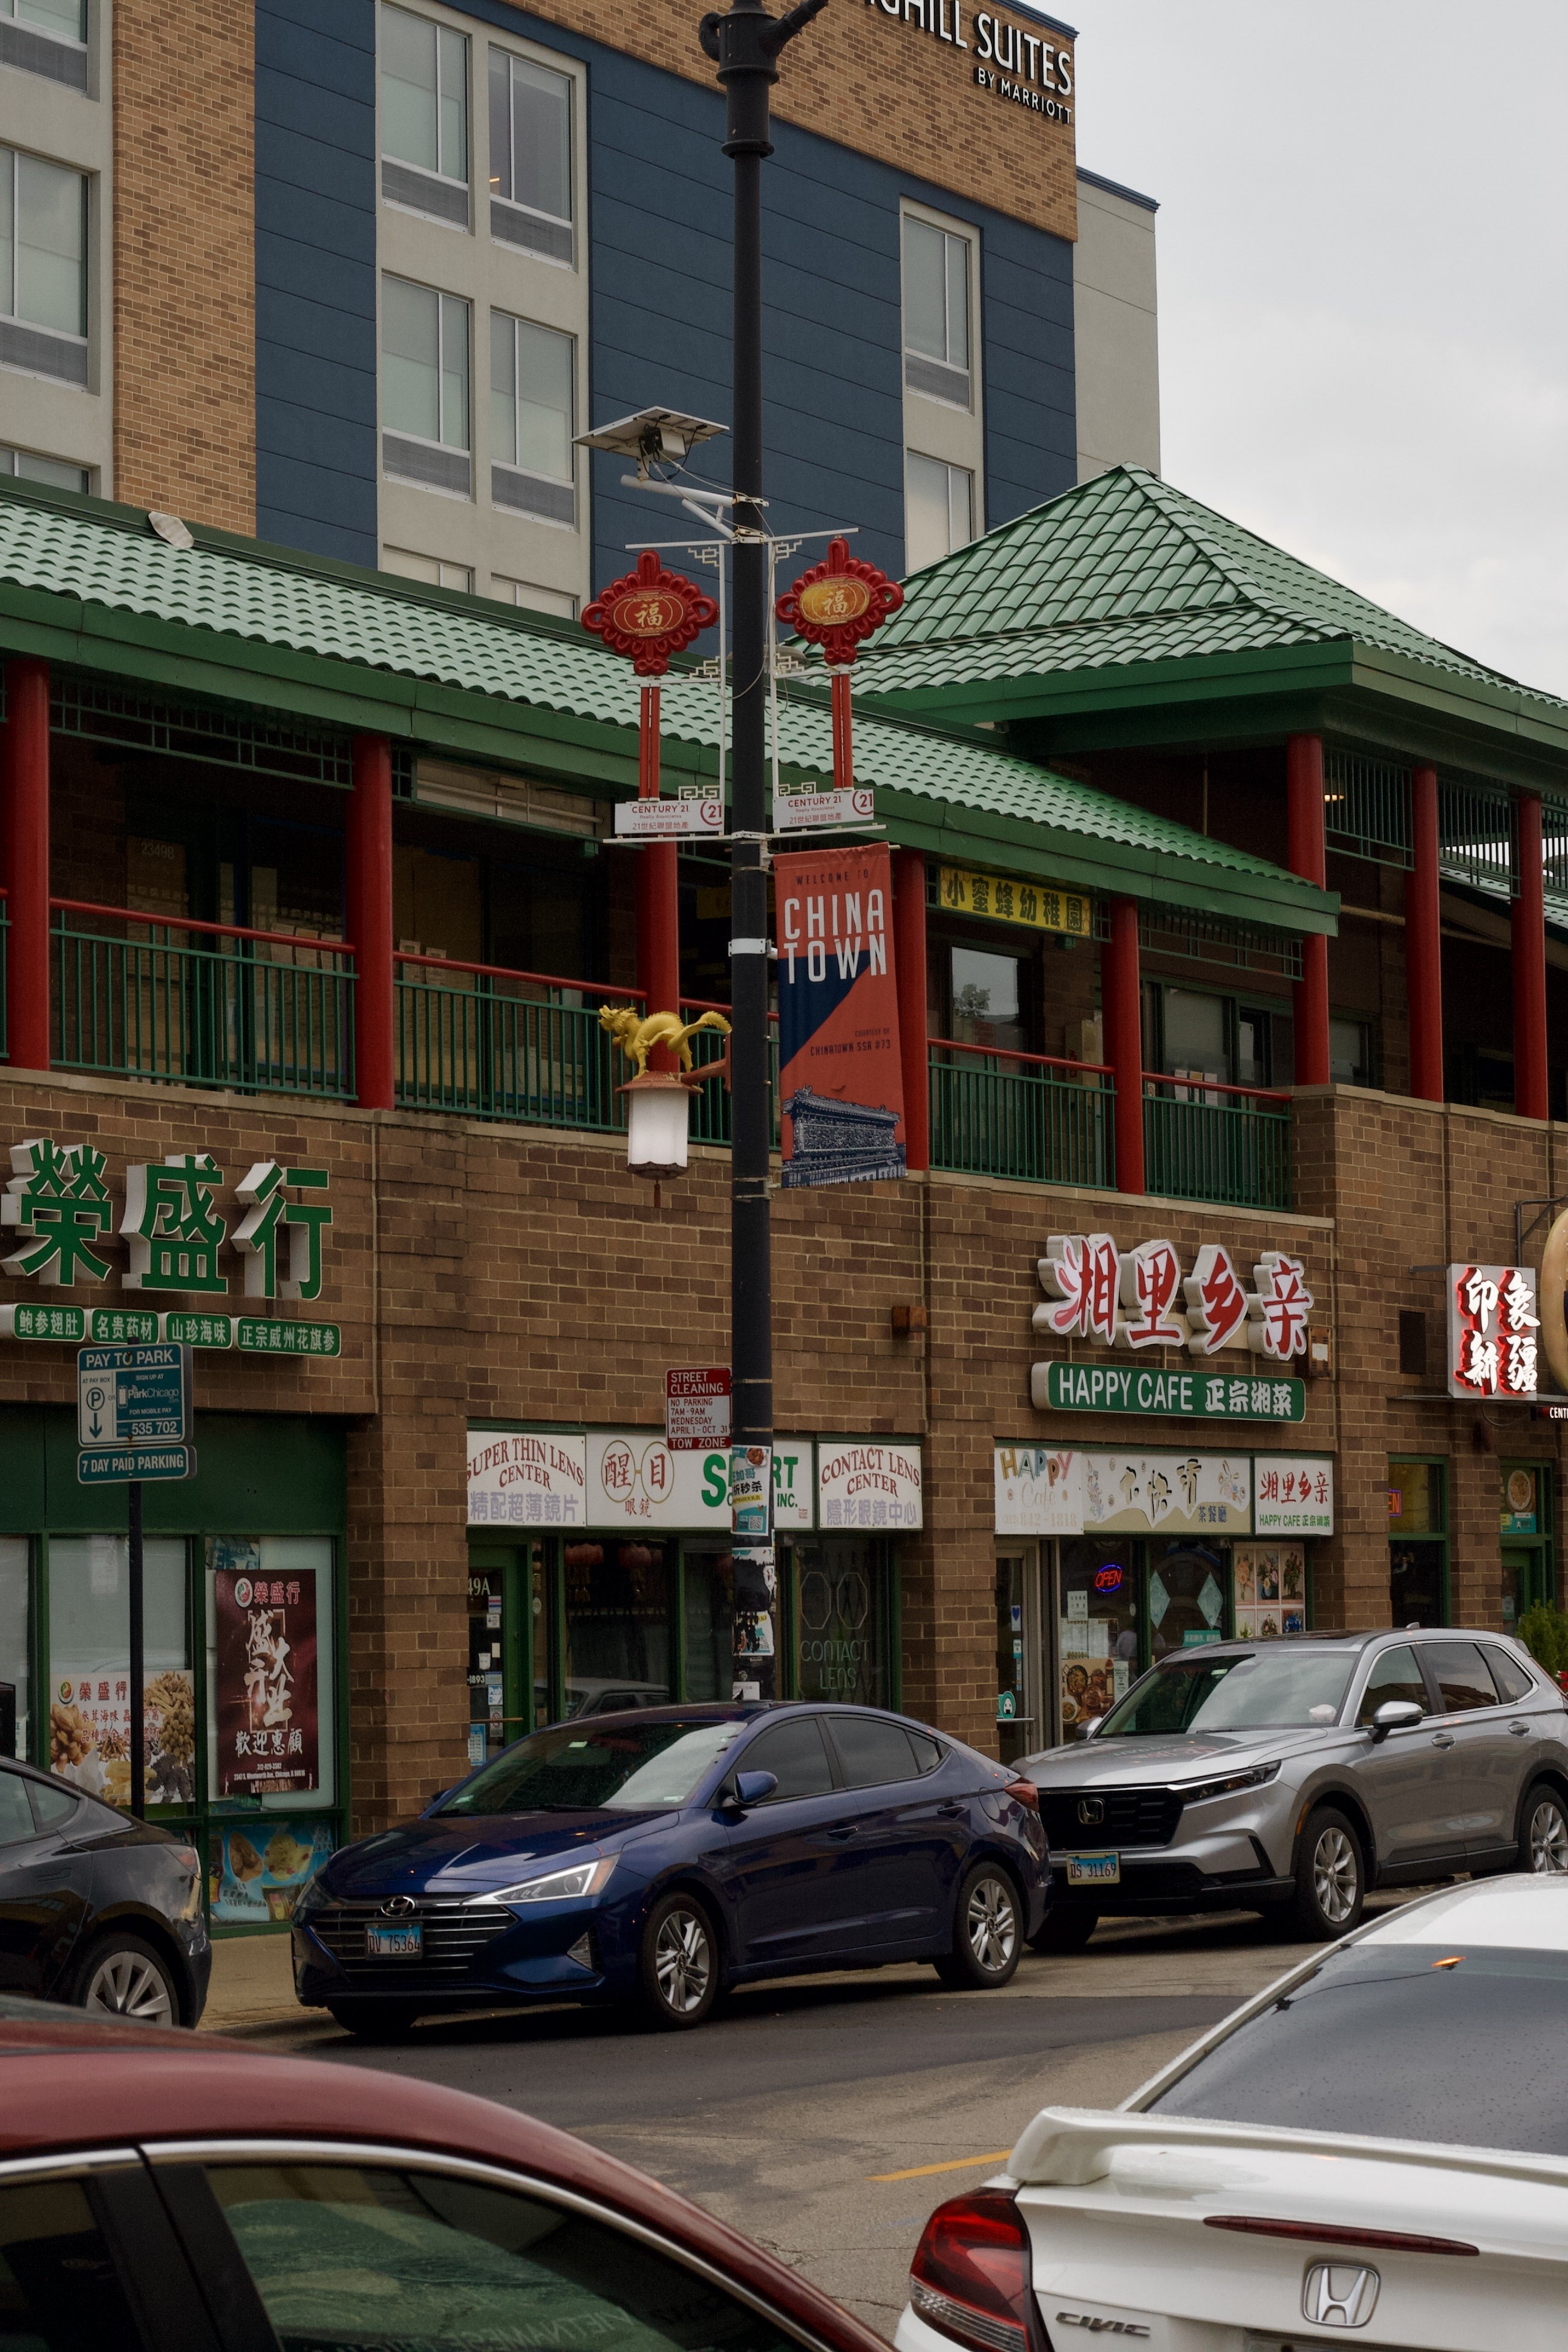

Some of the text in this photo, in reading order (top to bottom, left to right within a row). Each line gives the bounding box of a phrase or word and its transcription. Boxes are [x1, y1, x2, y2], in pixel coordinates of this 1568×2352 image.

[977, 13, 1072, 96] SUITES
[978, 67, 1072, 123] BY MARRIOTT
[820, 589, 848, 614] 福
[634, 602, 664, 627] 福
[788, 797, 831, 807] CENTURY
[797, 869, 869, 884] WELCOME TO
[785, 889, 884, 939] CHINA
[947, 872, 1082, 932] 小蜜蜂幼稚園
[783, 933, 887, 984] TOWN
[855, 1029, 881, 1037] COURTESY
[811, 1039, 890, 1056] CHINATOWN SSA #73
[17, 1138, 333, 1300] 榮盛行
[1050, 1234, 1312, 1359] 湘里乡亲
[19, 1310, 79, 1336] 鲍参翅肚
[97, 1314, 153, 1341] 名贵药材
[172, 1318, 226, 1342] 山珍海味
[241, 1324, 335, 1352] 正宗威州花旗参
[86, 1350, 174, 1368] PAY TO PARK
[670, 1382, 724, 1394] CLEANING
[671, 1371, 708, 1383] STREET
[1059, 1367, 1193, 1411] HAPPY CAFE
[1205, 1379, 1293, 1417] 正宗湘菜
[132, 1422, 152, 1435] 535
[155, 1421, 177, 1434] 702
[671, 1417, 713, 1425] WEDNESDAY
[671, 1437, 727, 1449] TOW ZONE
[81, 1454, 184, 1473] 7 DAY PAID PARKING
[467, 1438, 585, 1486] SUPER THIN LENS
[822, 1446, 920, 1487] CONTACT LENS
[999, 1448, 1073, 1488] HAPPY
[499, 1465, 552, 1491] CENTER
[701, 1454, 799, 1508] SRT
[847, 1473, 898, 1498] CENTER
[1260, 1471, 1330, 1504] 湘里乡亲
[470, 1491, 579, 1522] 精配超薄鏡片
[625, 1498, 652, 1518] 眼鏡
[777, 1493, 798, 1508] INC.
[826, 1498, 917, 1526] 隱形眼鏡中心
[1198, 1504, 1227, 1523] 茶餐廳
[1259, 1514, 1300, 1527] HAPPY CAFE
[1302, 1514, 1331, 1528] 正宗湘菜
[1094, 1569, 1122, 1588] OPEN
[253, 1581, 301, 1604] 榮盛行
[800, 1639, 869, 1662] CONTACT
[79, 1681, 127, 1700] 榮盛行
[820, 1667, 857, 1690] LENS
[235, 1728, 304, 1758] 歡迎惠顧
[1070, 1863, 1116, 1878] DS 31169
[368, 1934, 420, 1952] DV 75364
[1056, 2312, 1151, 2337] CIVIC
